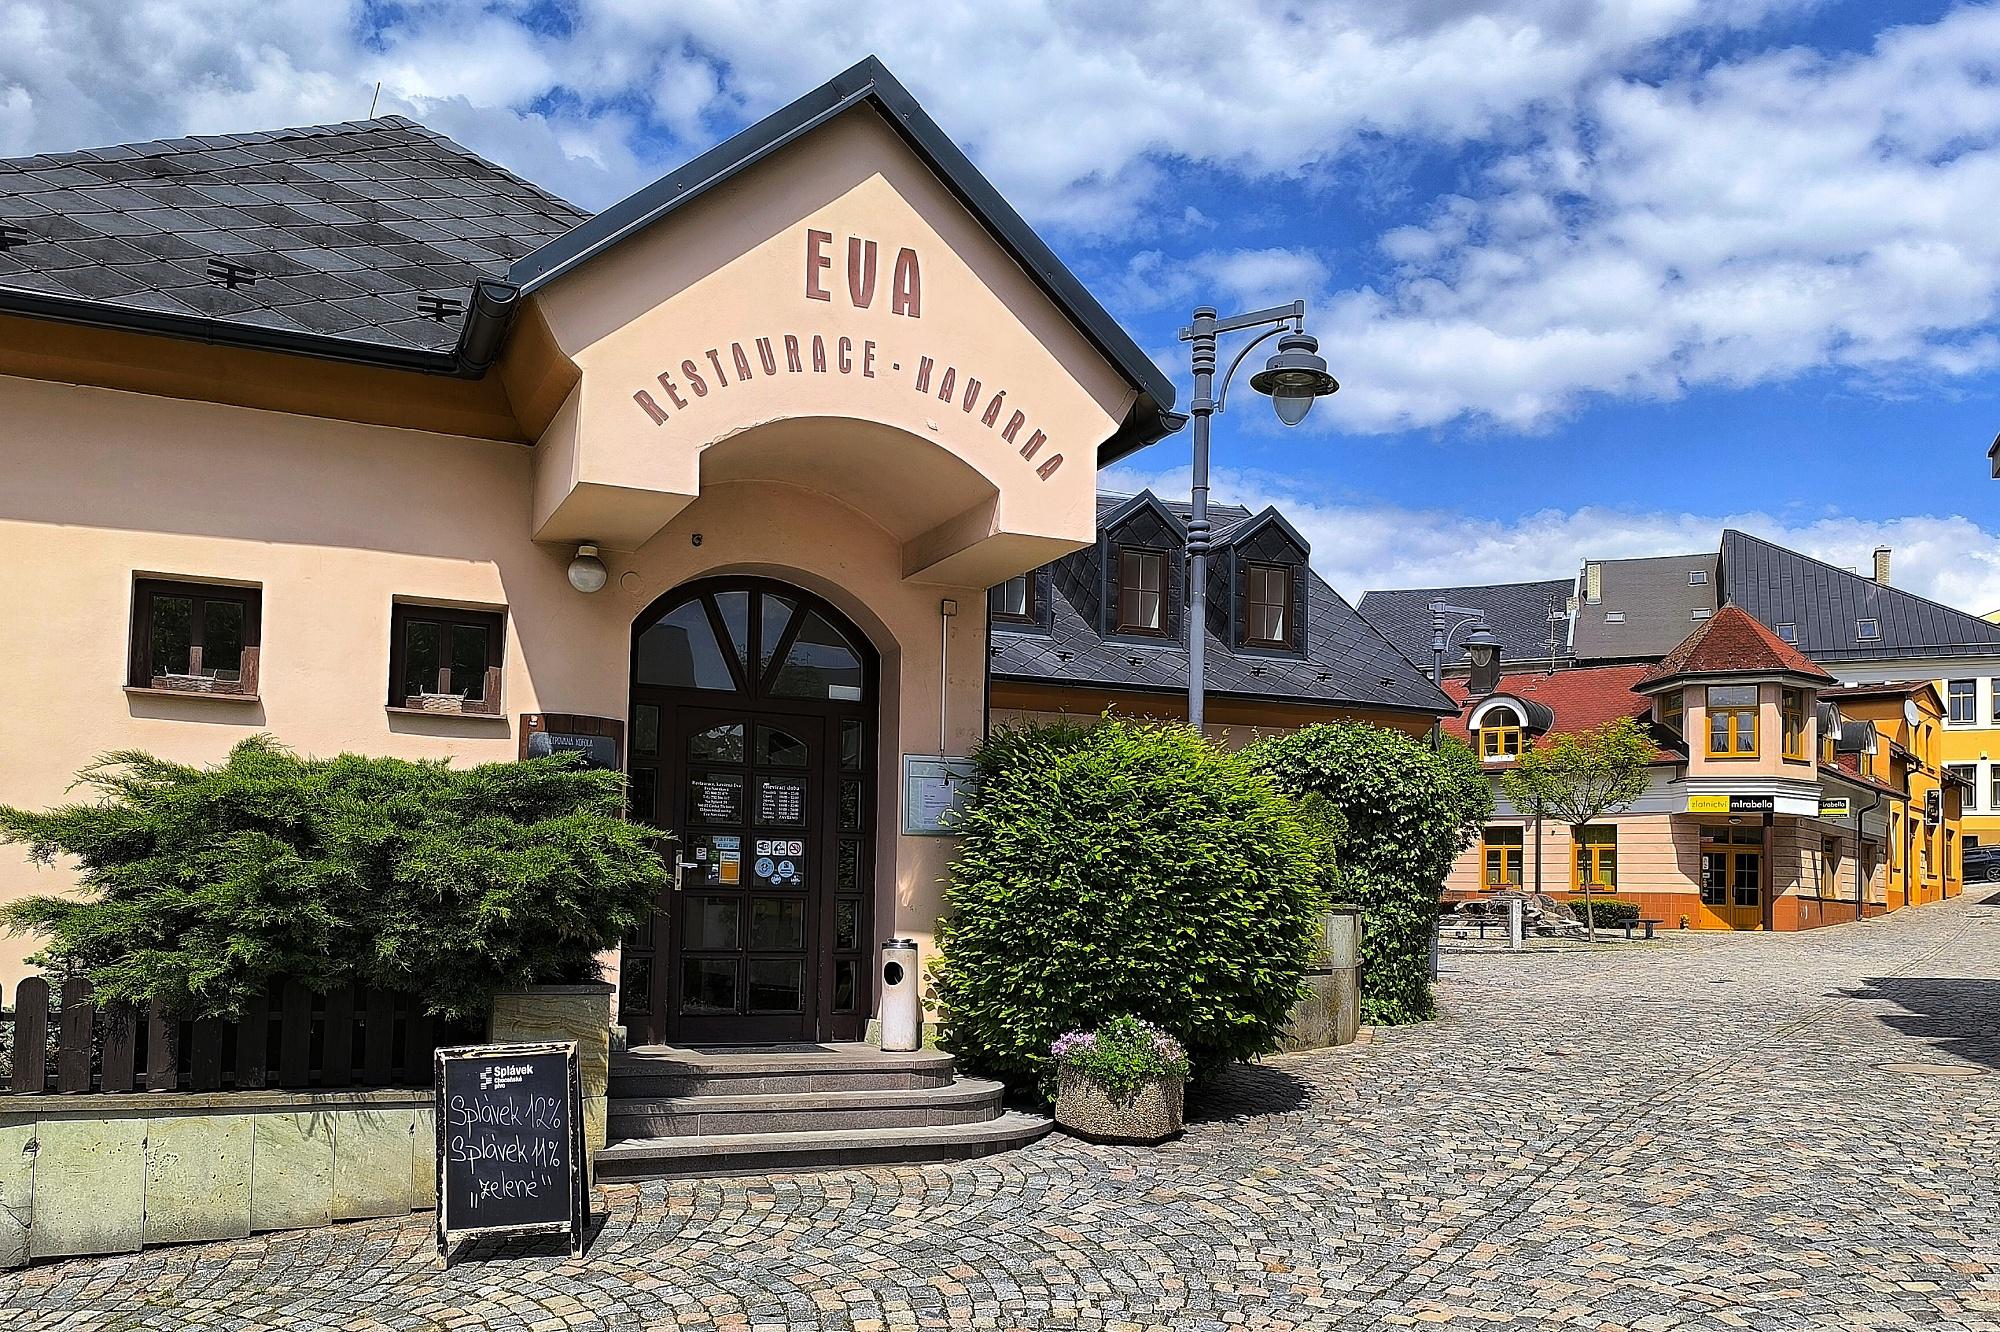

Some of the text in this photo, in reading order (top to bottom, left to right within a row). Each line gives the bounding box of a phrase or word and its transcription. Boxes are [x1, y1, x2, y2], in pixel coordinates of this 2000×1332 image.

[806, 229, 921, 318] EVA
[633, 335, 876, 426] RESTAURACE
[915, 355, 1064, 481] KAVÁRNA
[1731, 800, 1773, 808] mirabella
[494, 1064, 533, 1078] Splávek
[449, 1093, 561, 1139] Splávek 12%
[450, 1133, 560, 1175] Splávek 11%
